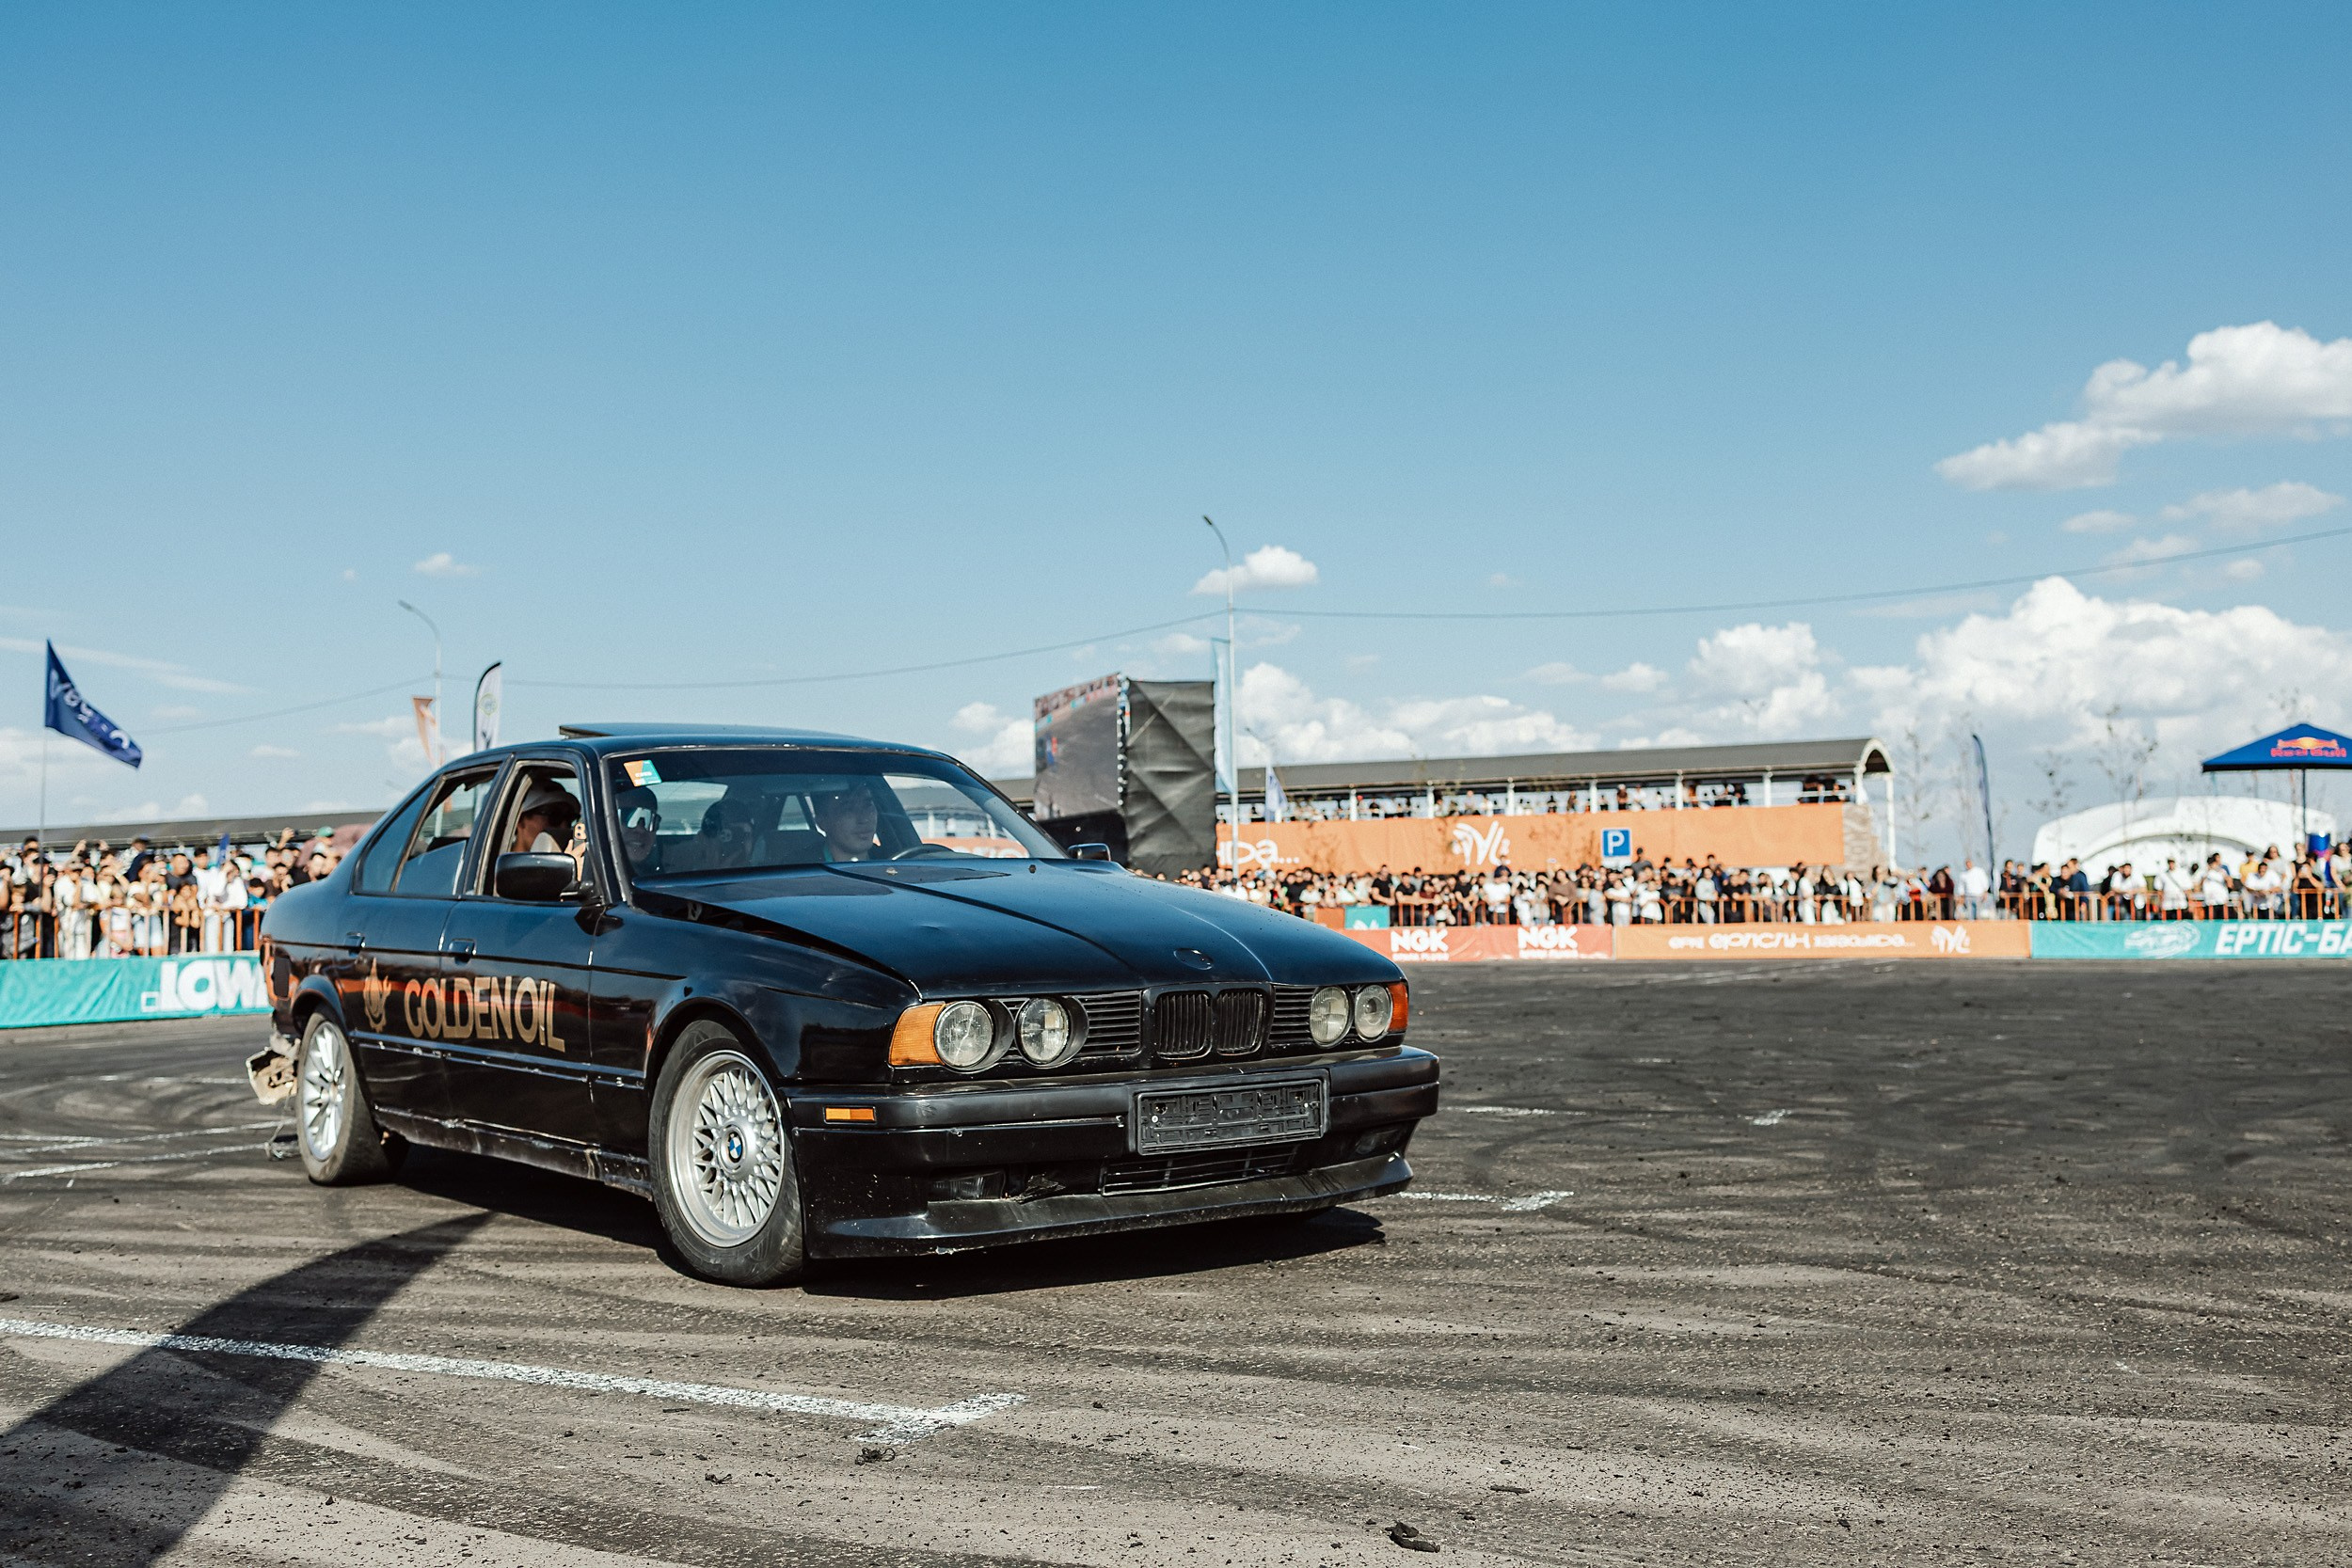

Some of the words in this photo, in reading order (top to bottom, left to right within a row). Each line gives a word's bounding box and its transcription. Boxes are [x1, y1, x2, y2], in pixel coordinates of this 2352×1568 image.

[1607, 831, 1625, 855] P
[1391, 928, 1449, 952] NGK
[1518, 926, 1578, 949] NGK
